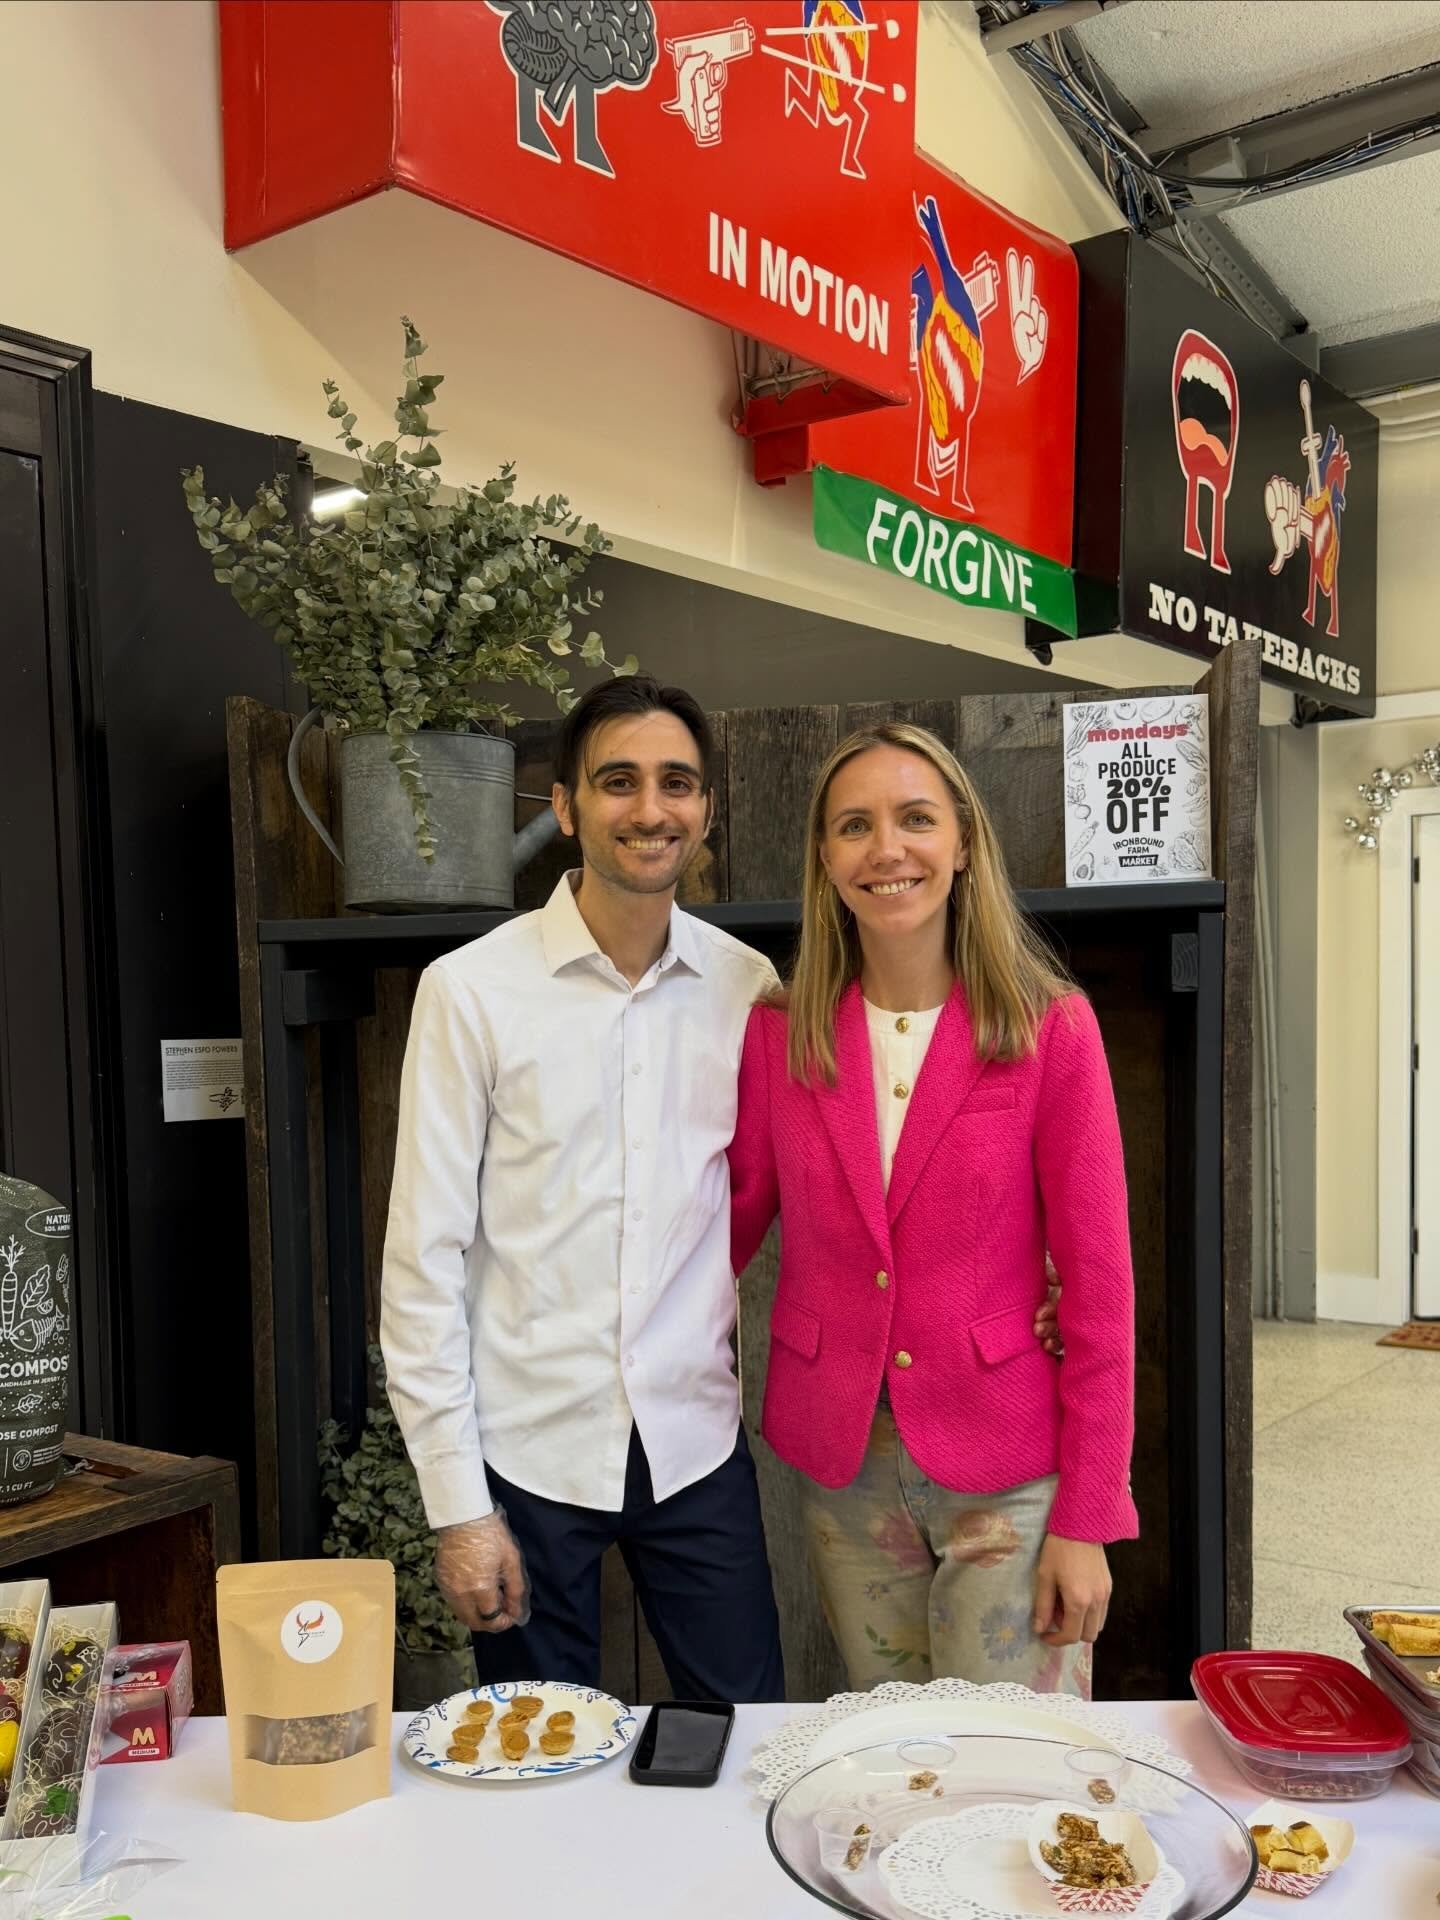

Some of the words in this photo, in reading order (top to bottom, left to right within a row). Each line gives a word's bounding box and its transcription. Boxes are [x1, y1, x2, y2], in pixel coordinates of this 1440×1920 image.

[709, 211, 747, 288] IN
[760, 237, 889, 356] MOTION
[866, 498, 1037, 614] FORGIVE
[1149, 583, 1198, 632] NO
[1088, 721, 1190, 742] mondays
[1121, 742, 1152, 759] ALL
[1098, 758, 1176, 779] PRODUCE
[1107, 777, 1171, 799] 20%
[1107, 797, 1170, 834] OFF
[1113, 837, 1165, 850] IRONBOUND
[1128, 846, 1149, 854] FARM
[1122, 857, 1156, 866] MARKET
[0, 1354, 70, 1379] COMPOS
[19, 1424, 59, 1439] COMPOST
[132, 1727, 156, 1745] M
